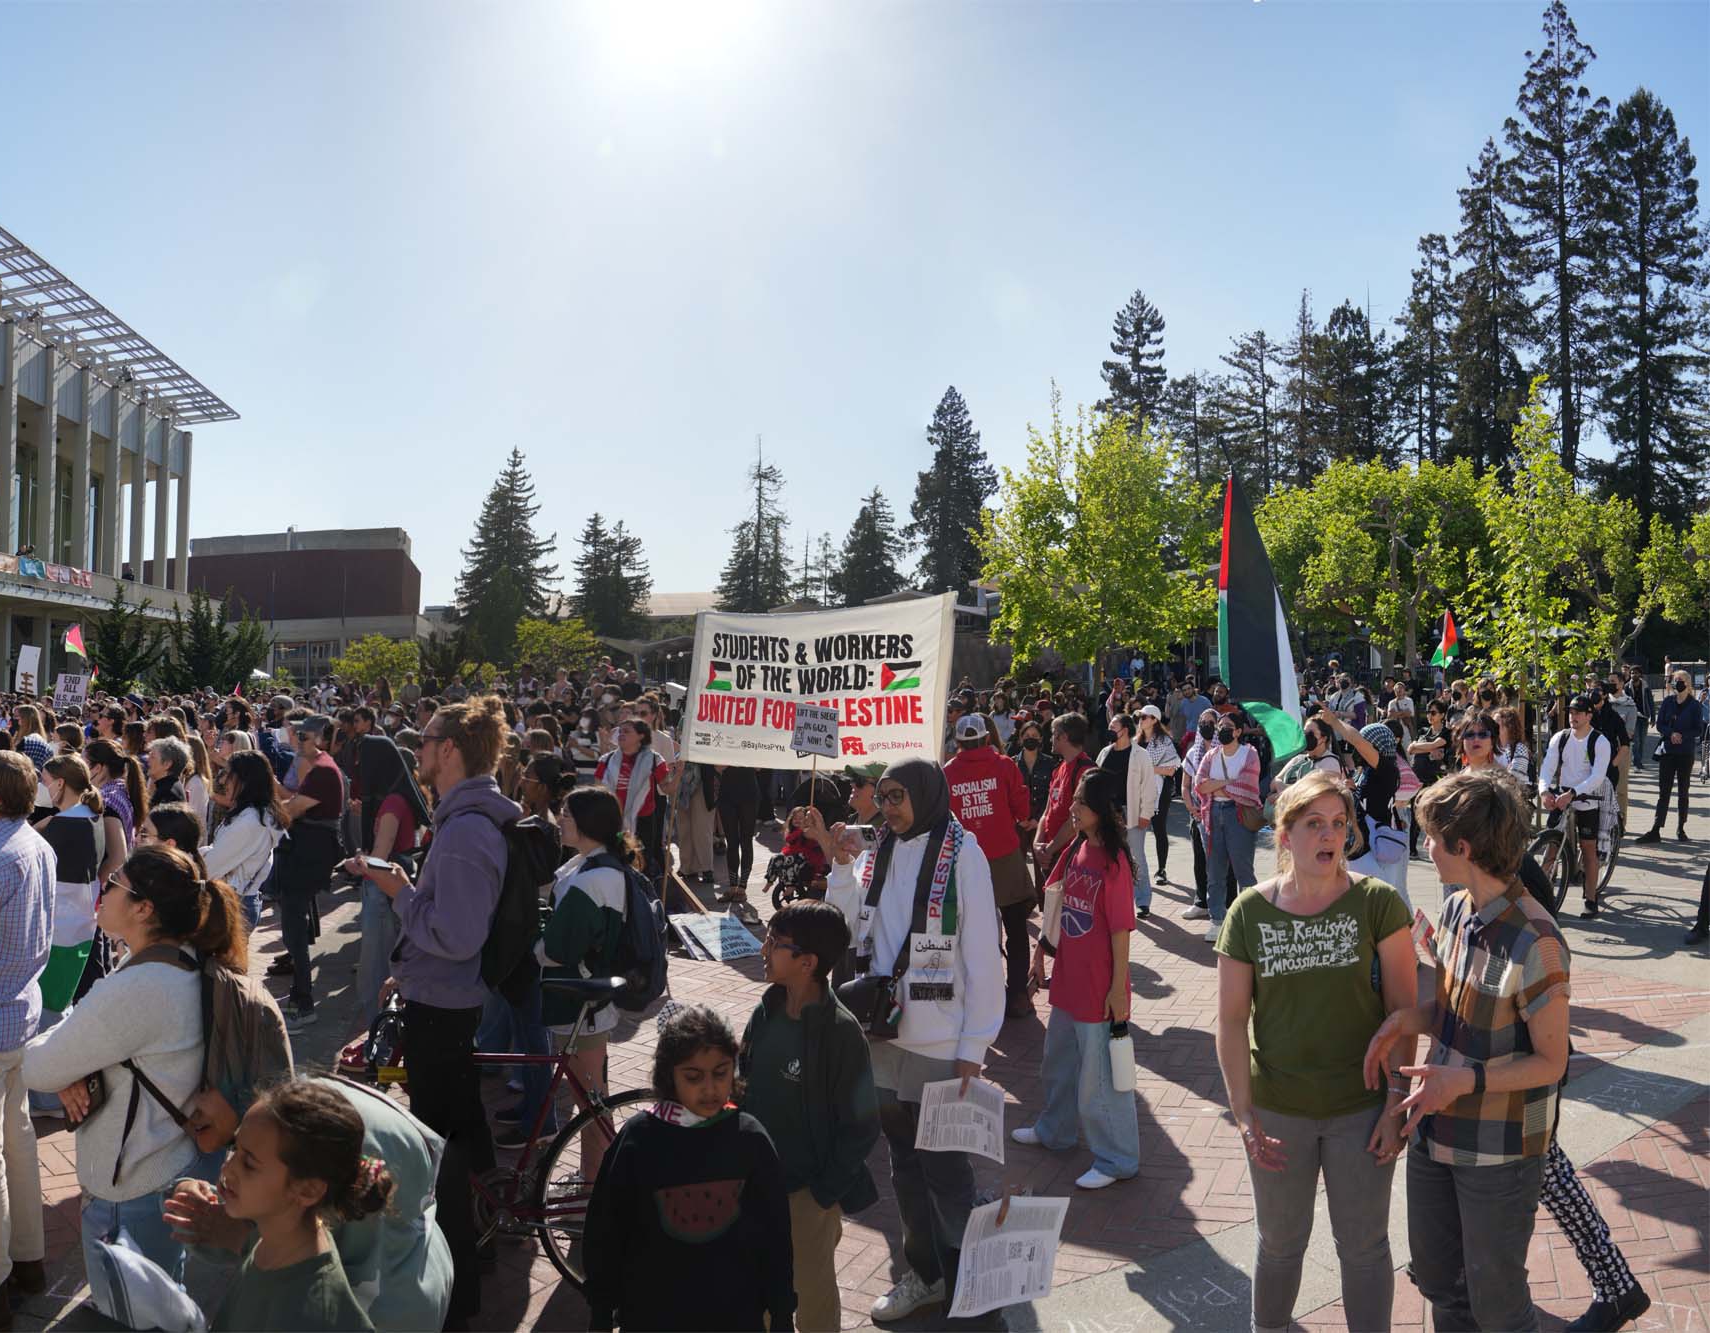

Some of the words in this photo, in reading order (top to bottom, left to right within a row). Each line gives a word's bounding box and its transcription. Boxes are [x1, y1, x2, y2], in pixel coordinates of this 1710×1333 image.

[712, 632, 790, 664] STUDENTS
[794, 642, 808, 666] &
[814, 633, 914, 663] WORKERS
[64, 675, 80, 684] END
[736, 664, 757, 690] OF
[760, 664, 792, 693] THE
[797, 664, 875, 695] WORLD:
[63, 684, 77, 693] ALL
[697, 694, 757, 727] UNITED
[762, 699, 796, 731] FOR
[805, 695, 923, 728] LESTINE
[812, 723, 827, 733] GAZA
[839, 736, 868, 755] PSL
[951, 777, 998, 797] SOCIALISM
[961, 795, 971, 807] IS
[972, 793, 989, 805] THE
[960, 803, 994, 820] FUTURE
[1315, 940, 1335, 952] THE
